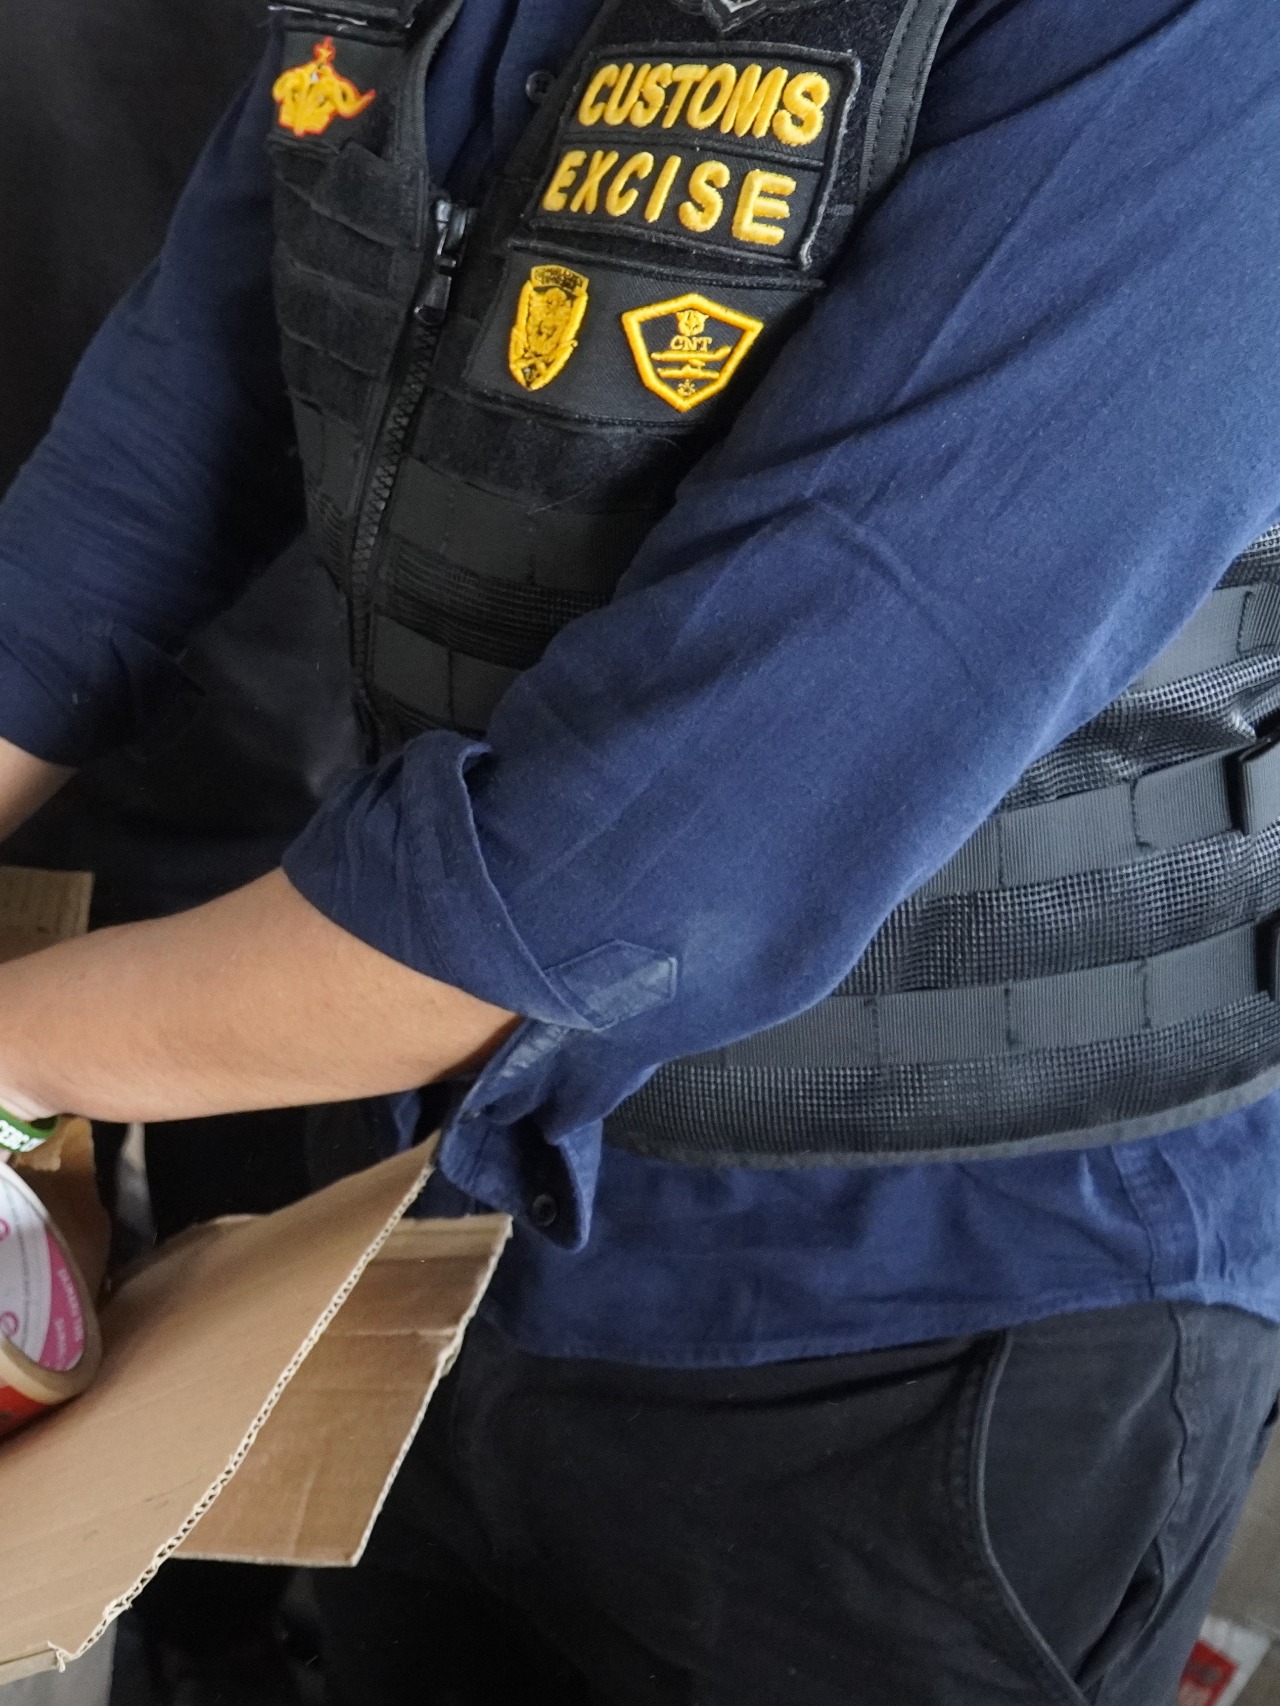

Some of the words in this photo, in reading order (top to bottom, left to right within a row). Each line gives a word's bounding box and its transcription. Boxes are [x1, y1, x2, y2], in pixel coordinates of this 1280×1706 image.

[577, 62, 831, 147] CUSTOMS
[541, 149, 797, 246] EXCISE
[670, 335, 713, 353] CNT
